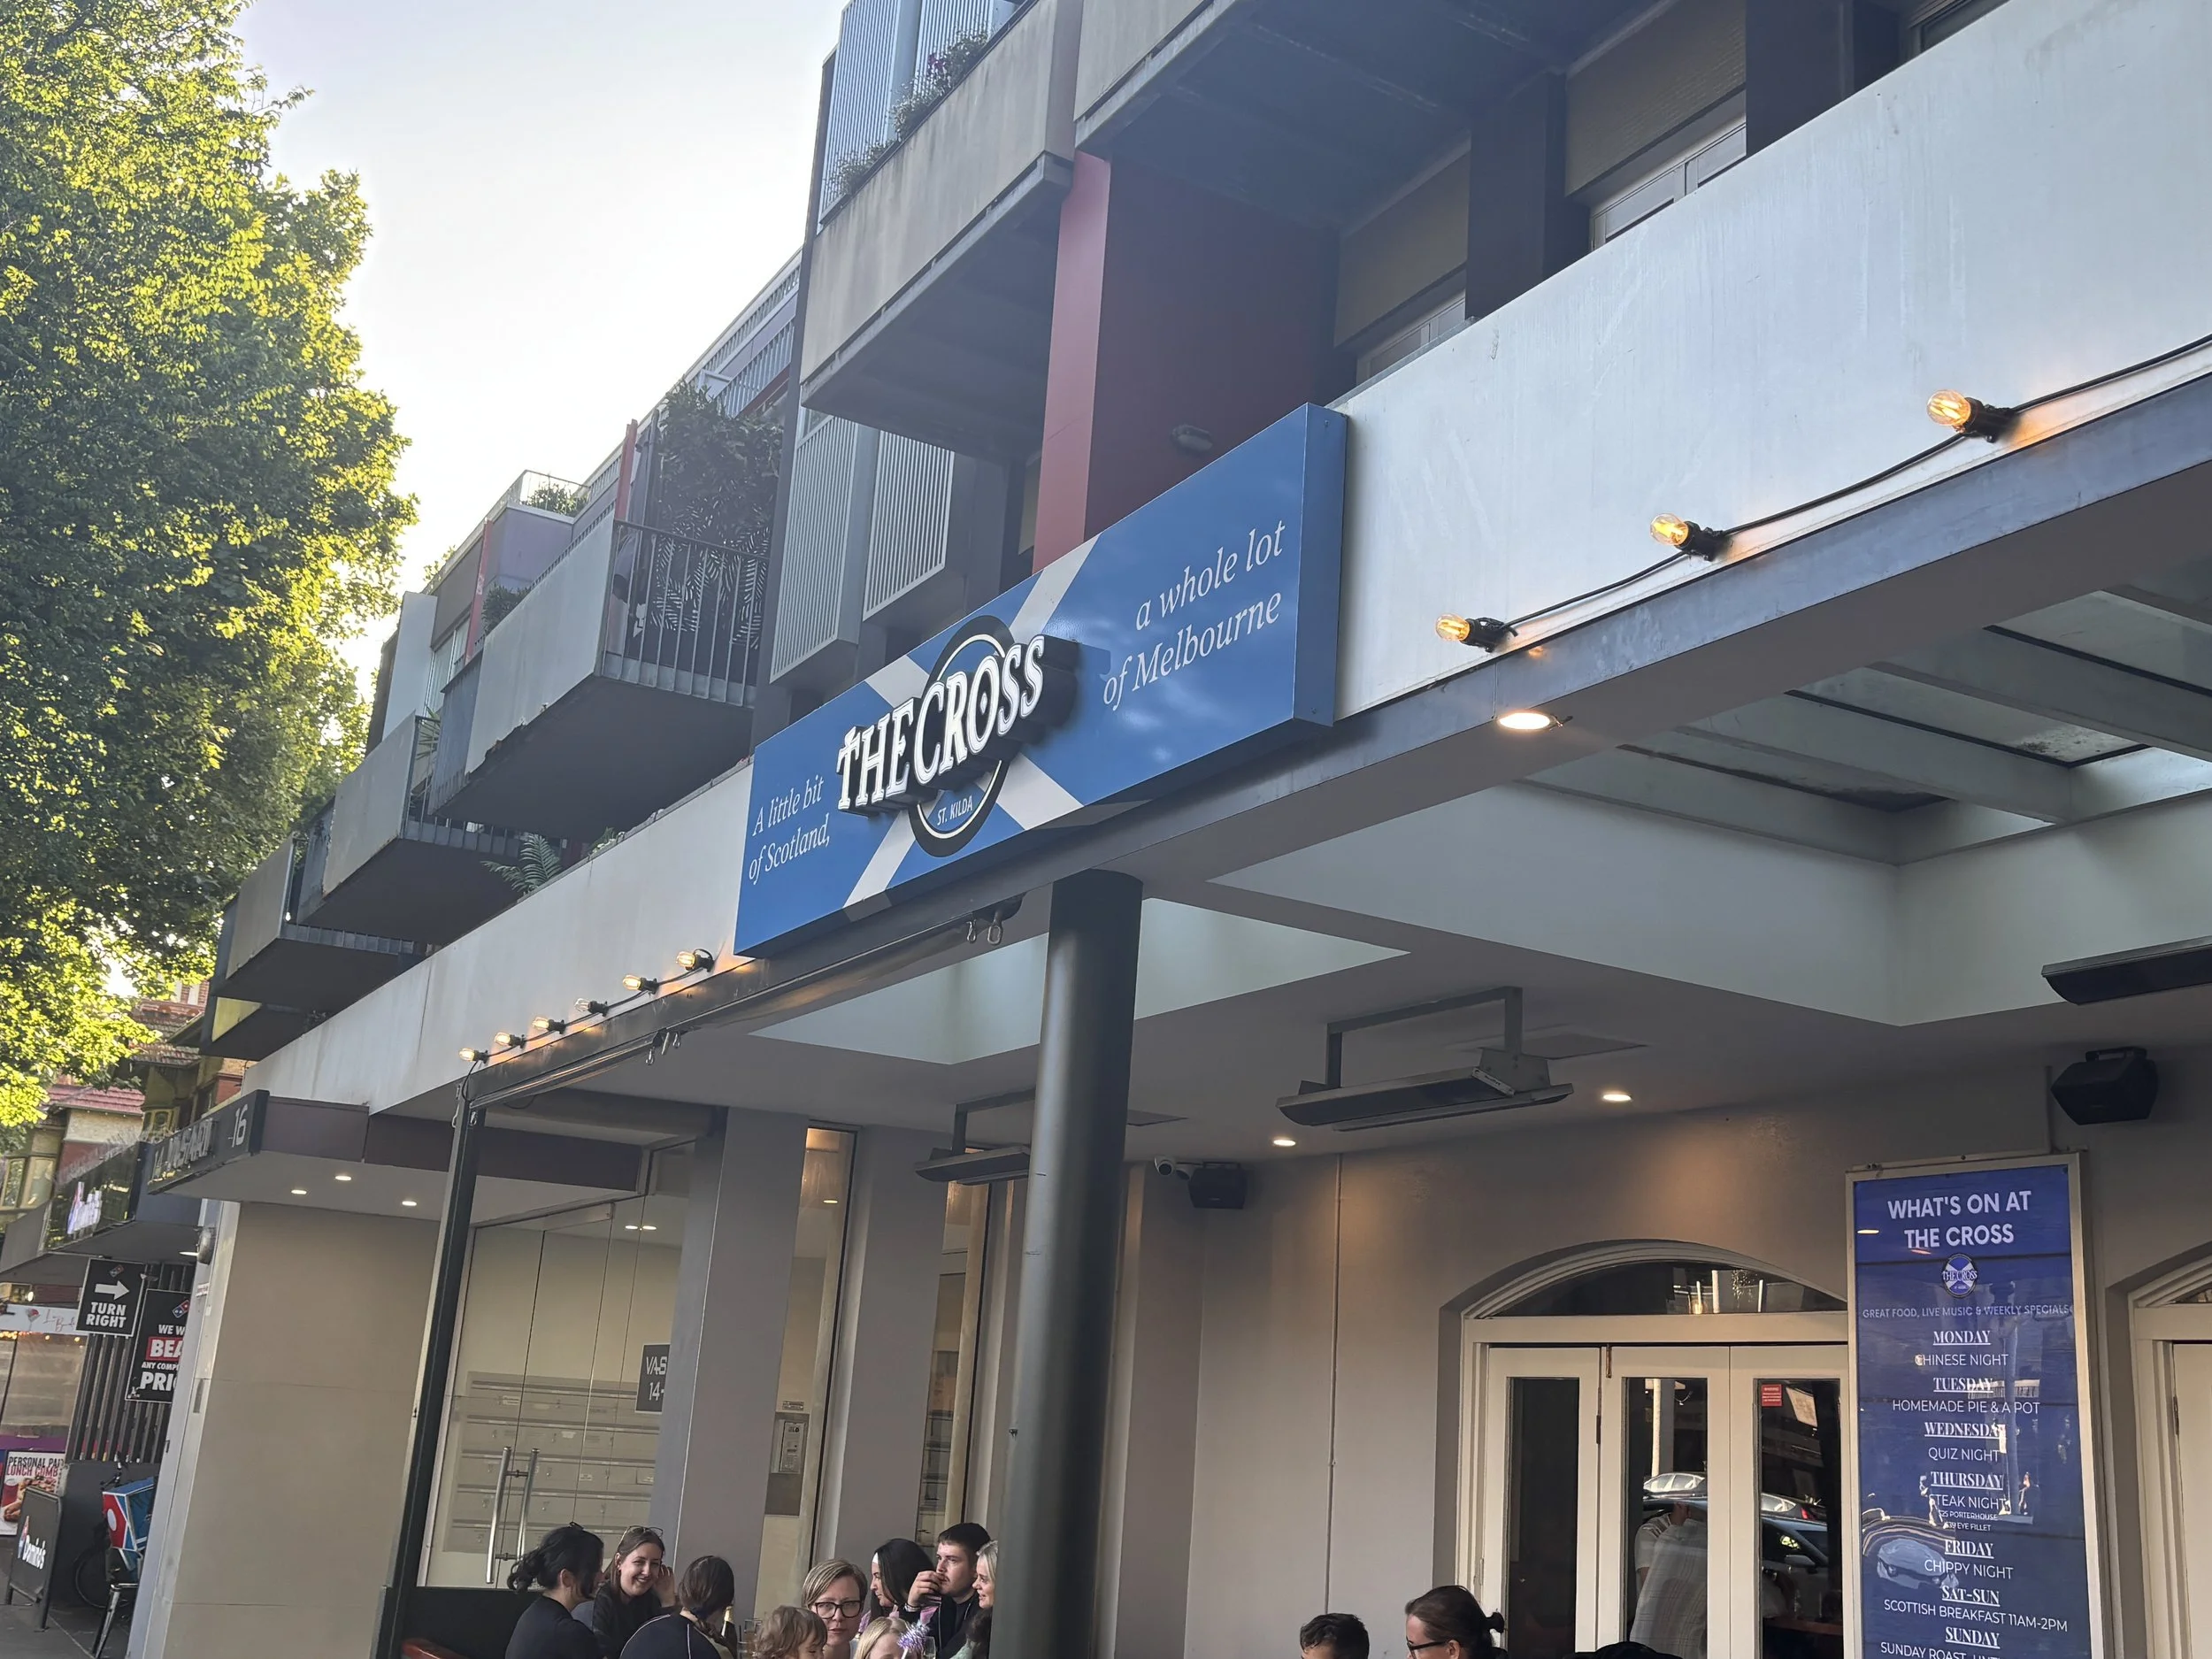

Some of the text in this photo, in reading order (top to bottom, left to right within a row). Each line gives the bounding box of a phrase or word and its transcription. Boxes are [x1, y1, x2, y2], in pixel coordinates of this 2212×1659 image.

[1136, 520, 1286, 631] a whole lot
[1103, 592, 1281, 710] of Melbourne
[836, 634, 1045, 810] THE CROSS
[752, 774, 825, 837] A little bit
[937, 795, 973, 826] ST. KILDA
[749, 813, 830, 885] of Scotland,
[1888, 1190, 2032, 1219] WHAT'S ON AT
[1904, 1223, 2015, 1248] THE CROSS
[90, 1302, 127, 1317] TURN
[1863, 1304, 2070, 1318] GREAT FOOD, LIVE MUSIC & WEEKLY SPECIALS
[86, 1313, 127, 1328] RIGHT
[158, 1324, 173, 1335] WE
[1933, 1330, 1991, 1344] MONDAY
[142, 1361, 180, 1371] ANY COMP
[1915, 1354, 2008, 1366] CHINESE NIGHT
[1933, 1377, 1993, 1392] TUESDAY
[1893, 1400, 2040, 1415] HOMEMADE PIE & A POT
[1924, 1422, 2005, 1438] WEDNESDA
[8, 1456, 46, 1468] PERSONAL
[1929, 1447, 2001, 1462] QUIZ NIGHT
[6, 1465, 33, 1476] LUNCH
[1931, 1471, 2003, 1489] THURSDAY
[1969, 1496, 2007, 1510] NIGHT
[1949, 1510, 1999, 1521] PORTERHOUSE
[1970, 1523, 1992, 1532] FILLET
[1945, 1539, 1994, 1558] FRIDAY
[1924, 1559, 2014, 1579] CHIPPY NIGHT
[1942, 1586, 2000, 1606] SAT-SUN
[1884, 1599, 2068, 1632] SCOTTISH BREAKFAST 11AM-2PM
[1946, 1626, 2000, 1647] SUNDAY
[1880, 1641, 1967, 1659] SUNDAY ROAST
